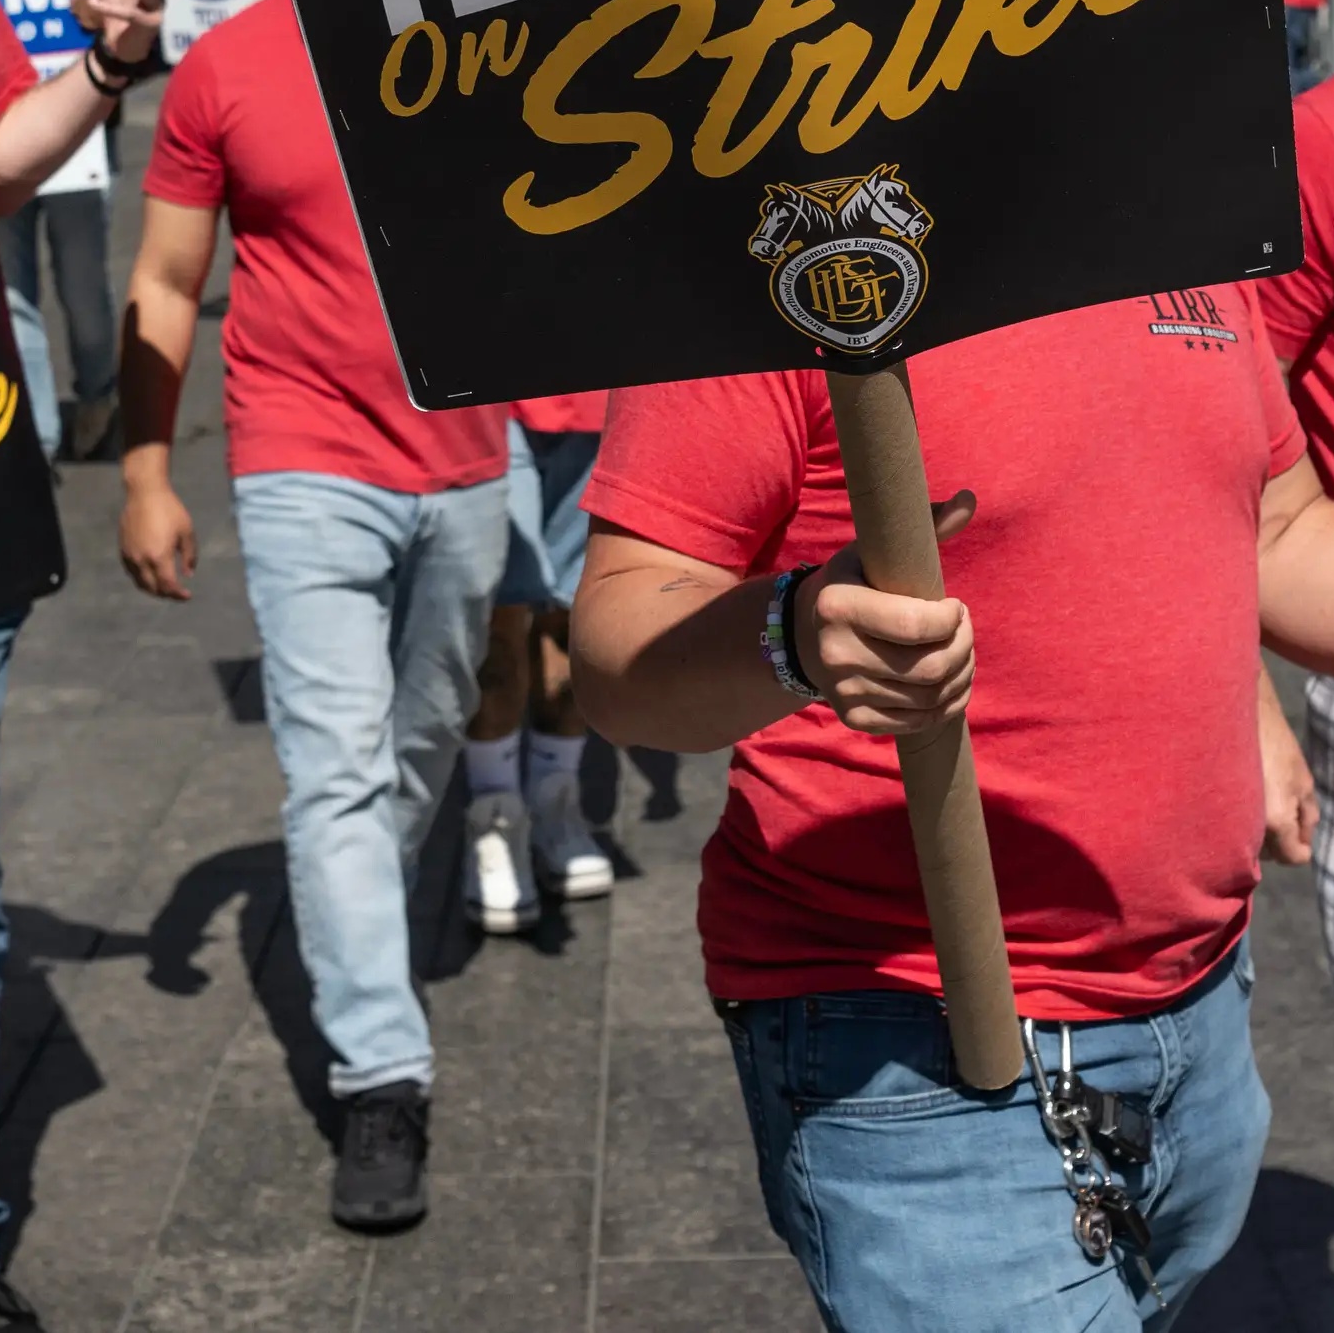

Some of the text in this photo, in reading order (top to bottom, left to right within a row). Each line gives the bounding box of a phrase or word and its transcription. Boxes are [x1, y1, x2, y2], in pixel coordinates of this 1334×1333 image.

[16, 18, 64, 42] ON
[381, 19, 528, 116] On
[781, 238, 917, 333] Brotherhood of Locomotive Engineers and Trainmen
[1149, 289, 1225, 326] LIRR
[847, 335, 870, 346] IBT
